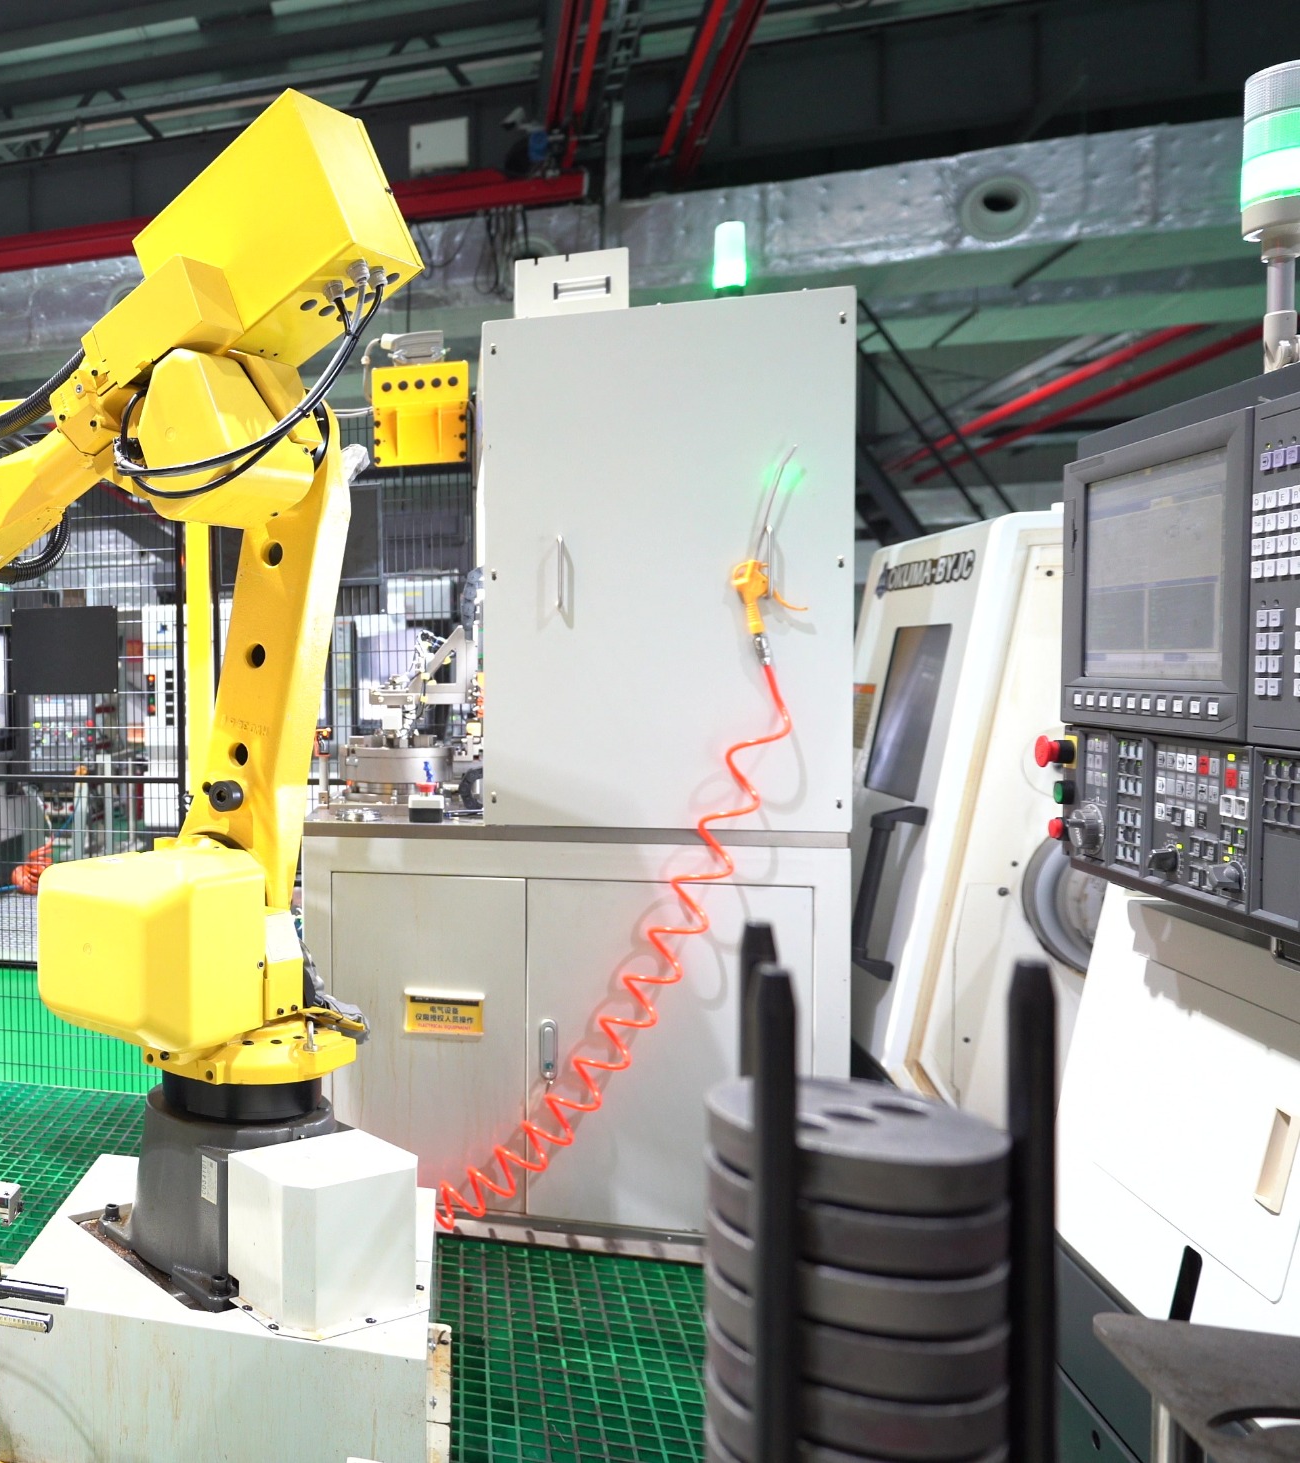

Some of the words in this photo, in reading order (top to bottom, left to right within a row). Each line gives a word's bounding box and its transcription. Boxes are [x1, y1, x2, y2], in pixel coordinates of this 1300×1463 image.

[1280, 493, 1285, 501] E
[887, 549, 976, 592] OKUMA-BYJC
[430, 1006, 458, 1015] 电气设备
[415, 1013, 474, 1024] 仅限授权人员操作
